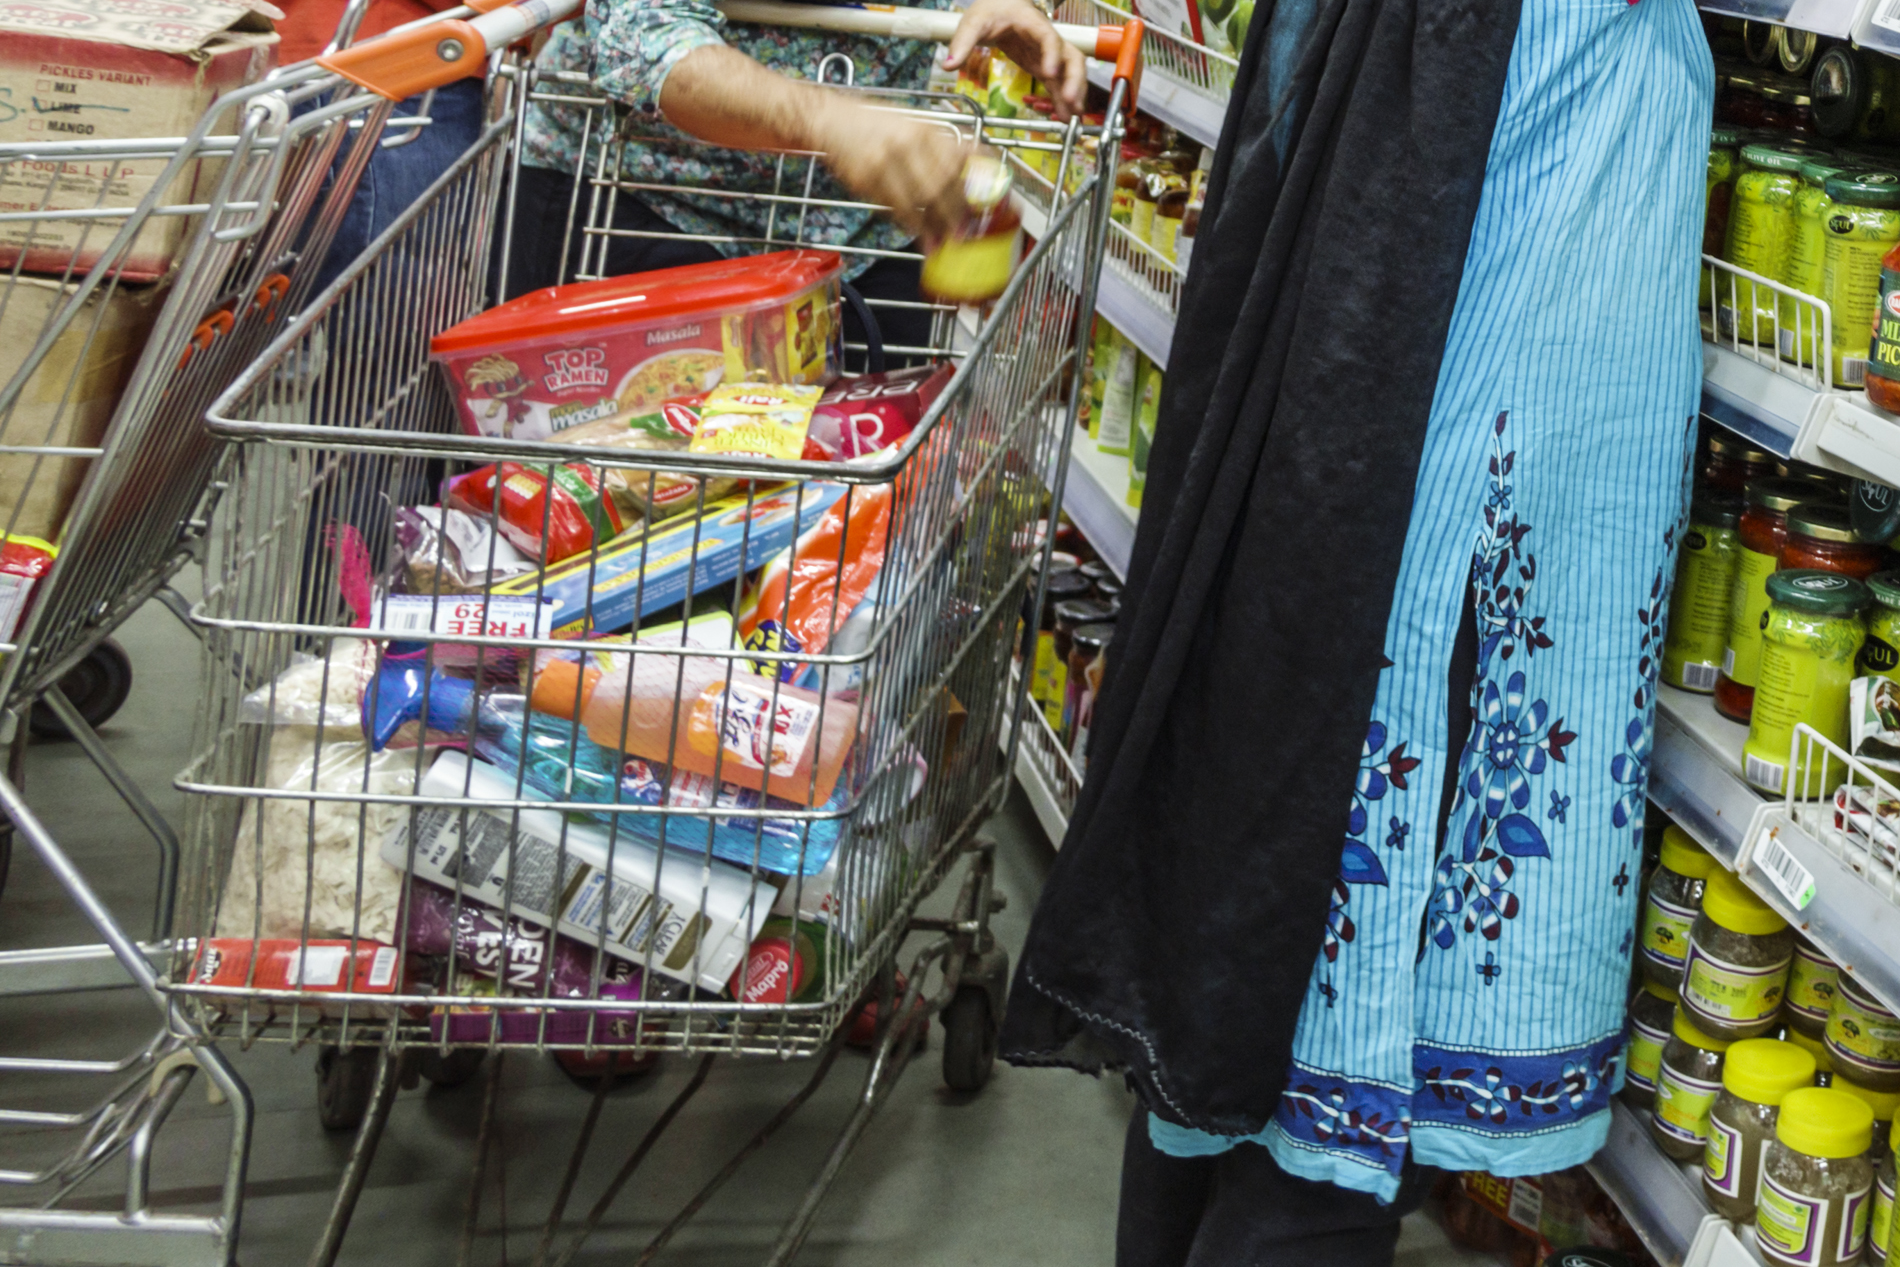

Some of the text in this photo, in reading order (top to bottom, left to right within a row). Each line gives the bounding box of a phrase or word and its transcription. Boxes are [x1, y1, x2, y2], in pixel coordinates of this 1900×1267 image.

[40, 64, 151, 85] PICKLES VARIANT
[54, 82, 77, 94] MIX
[50, 101, 81, 114] LIME
[48, 121, 94, 135] MANGO
[647, 325, 701, 346] Masala
[545, 348, 605, 373] TOP
[544, 368, 608, 392] RAMEN
[552, 400, 619, 432] masala
[447, 621, 526, 637] FREE
[745, 959, 789, 1002] Mapro
